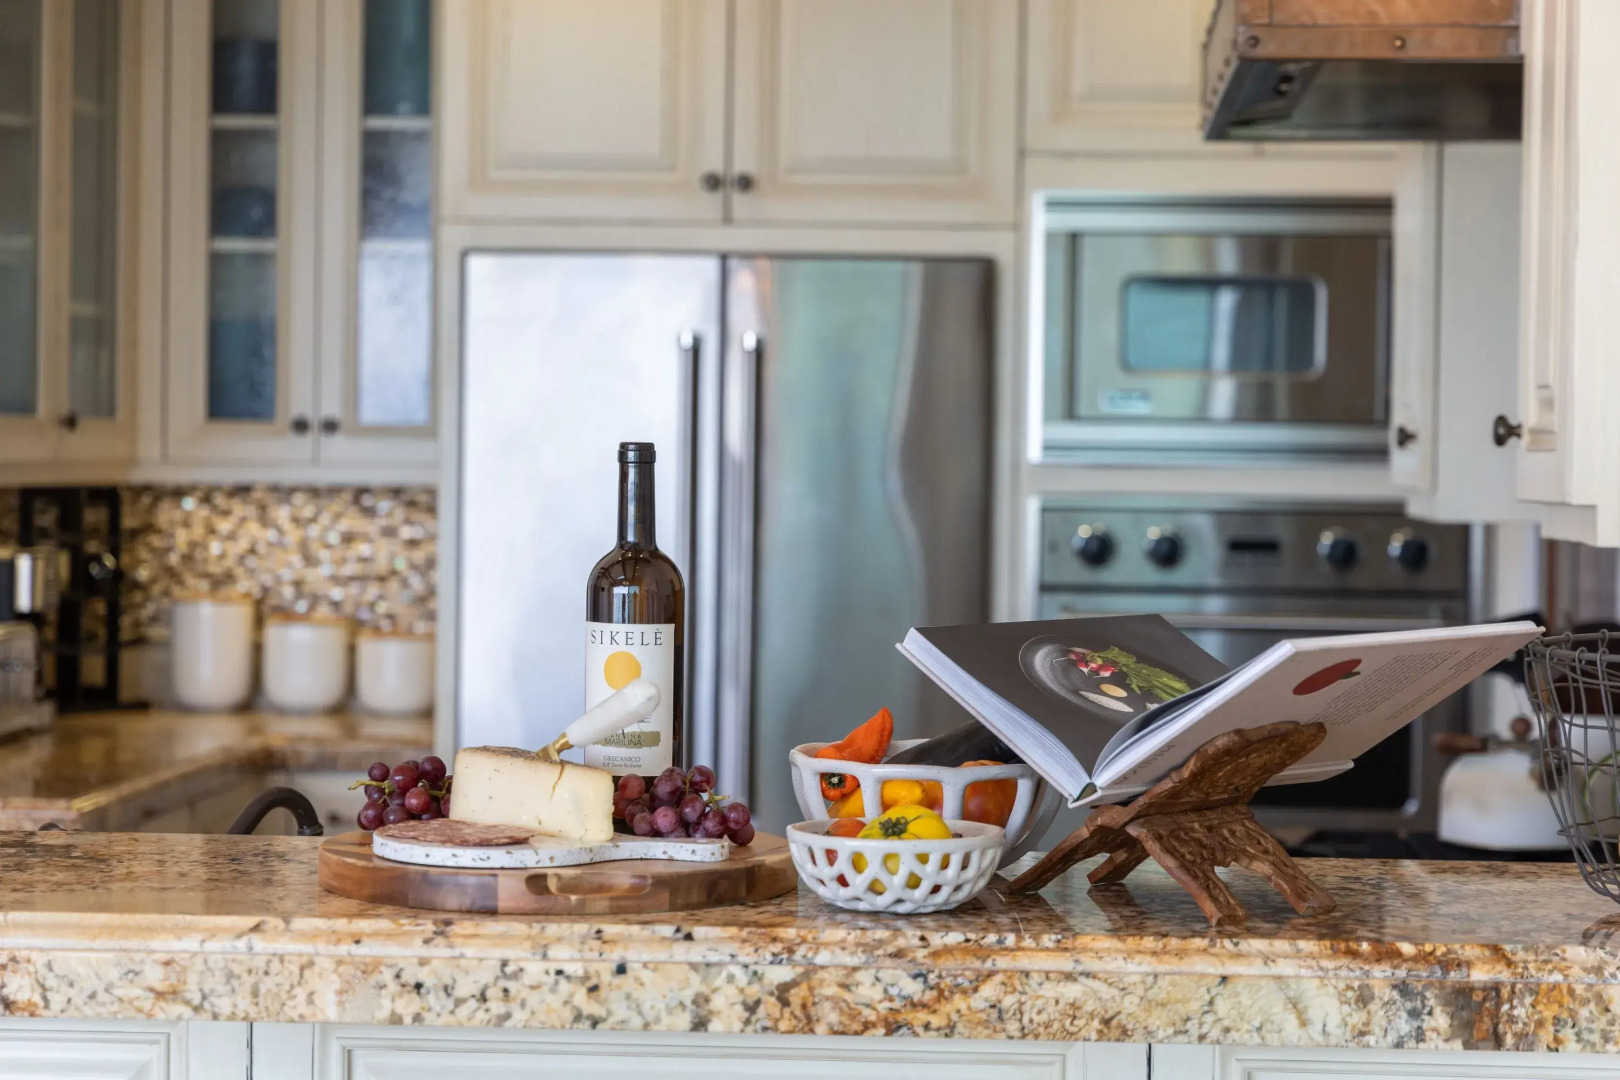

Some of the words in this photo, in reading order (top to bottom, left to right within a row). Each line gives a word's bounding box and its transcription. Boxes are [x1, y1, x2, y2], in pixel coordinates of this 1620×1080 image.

[590, 627, 663, 646] SIKELÈ
[604, 738, 642, 746] MARILINA
[603, 755, 642, 763] GRECANICO
